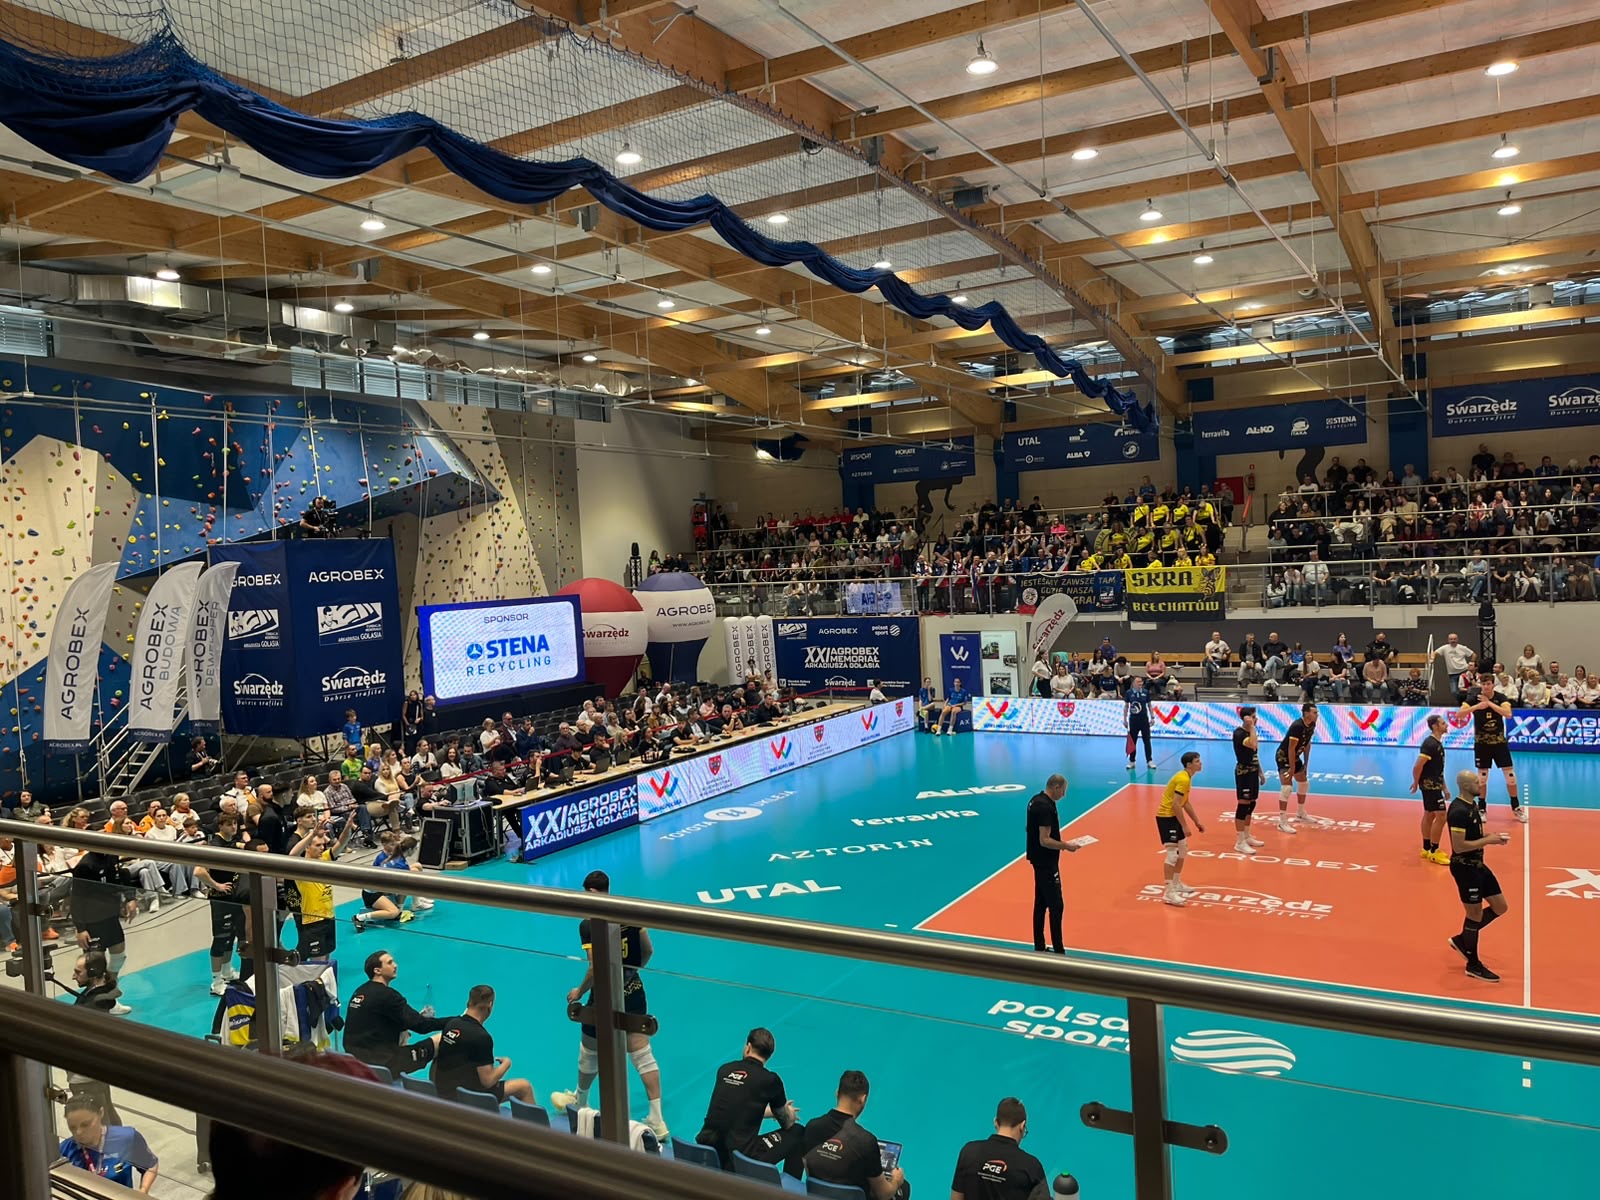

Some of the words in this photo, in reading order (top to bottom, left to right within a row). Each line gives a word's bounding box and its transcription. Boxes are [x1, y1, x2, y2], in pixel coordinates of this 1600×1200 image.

[1446, 400, 1517, 415] Swarzędz
[1333, 415, 1357, 424] STENA
[1018, 437, 1041, 446] UTAL
[231, 573, 281, 588] GROBEX
[308, 568, 385, 583] AGROBEX
[1061, 577, 1095, 586] ZAWSZE
[1131, 570, 1193, 588] SKRA
[1066, 586, 1094, 594] NASZA
[483, 612, 529, 624] SPONSOR
[818, 627, 858, 635] AGROBEX
[871, 624, 889, 632] polsat
[159, 606, 182, 681] BUDOWA
[486, 634, 550, 659] STENA
[746, 625, 755, 661] ROBEX
[761, 624, 772, 671] GROBEX
[830, 646, 880, 655] AGROBEX
[140, 602, 169, 711] AGROBEX
[731, 625, 743, 679] AGROBEX
[804, 646, 830, 663] XXI
[830, 655, 880, 663] MEMORIAŁ
[61, 607, 90, 720] AGROBEX
[466, 656, 552, 677] RECYCLING
[321, 670, 386, 691] Swarzędz
[824, 678, 856, 688] Swarzędz
[233, 681, 284, 698] Swarzędz
[1507, 715, 1568, 737] XXI
[1566, 717, 1600, 728] AG
[1507, 735, 1600, 746] ARKADIUSZA
[1566, 727, 1600, 737] ME
[568, 783, 638, 816] AGROBEX
[567, 798, 638, 828] MEMORIAŁ
[850, 808, 980, 827] terravita
[525, 804, 569, 843] XXI
[659, 821, 719, 841] TOYOTA
[525, 822, 595, 852] ARKADIUSZA
[767, 837, 934, 862] AZTORIN
[696, 878, 842, 904] UTAL
[987, 999, 1129, 1033] polsa
[728, 1072, 744, 1080] PGE
[822, 1141, 839, 1152] PGE
[982, 1162, 1003, 1174] PGE
